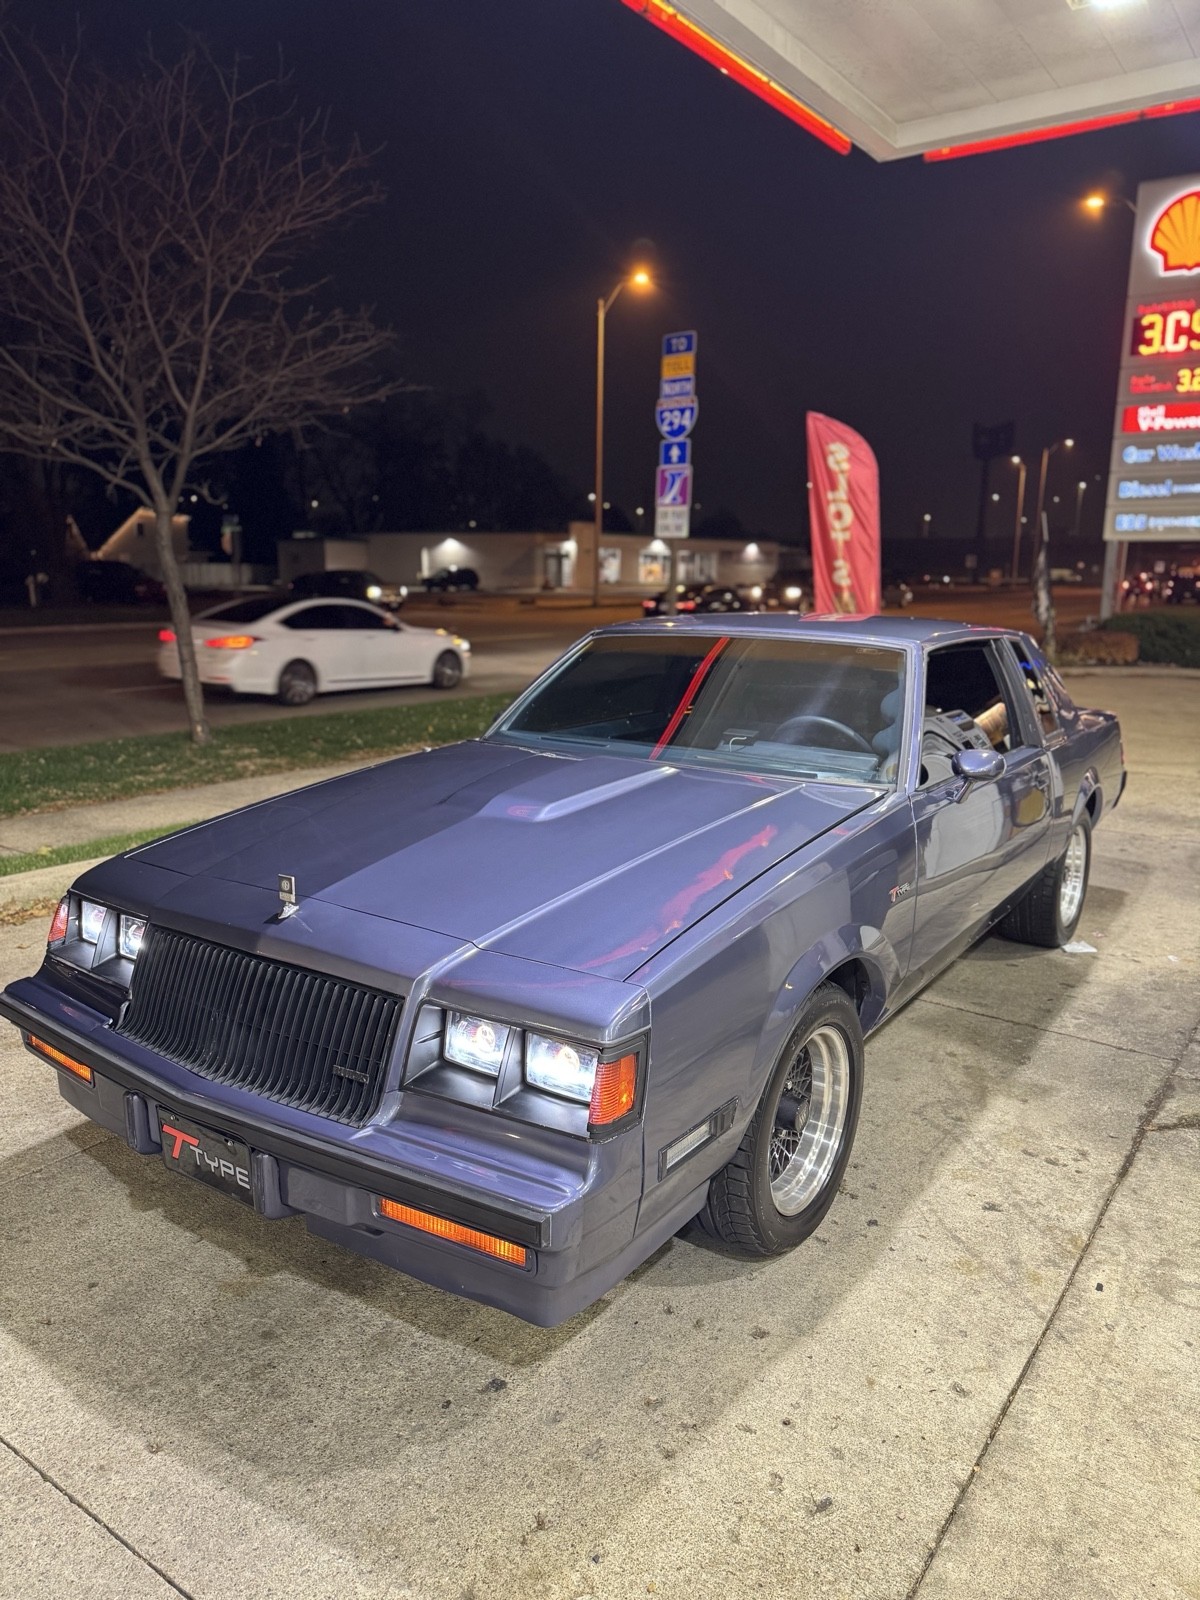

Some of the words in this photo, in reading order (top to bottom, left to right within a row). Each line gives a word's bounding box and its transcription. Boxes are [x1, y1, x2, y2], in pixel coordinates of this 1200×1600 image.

[671, 337, 688, 352] TO
[661, 408, 692, 432] 294
[162, 1124, 199, 1160] T
[189, 1145, 251, 1190] TYPE
